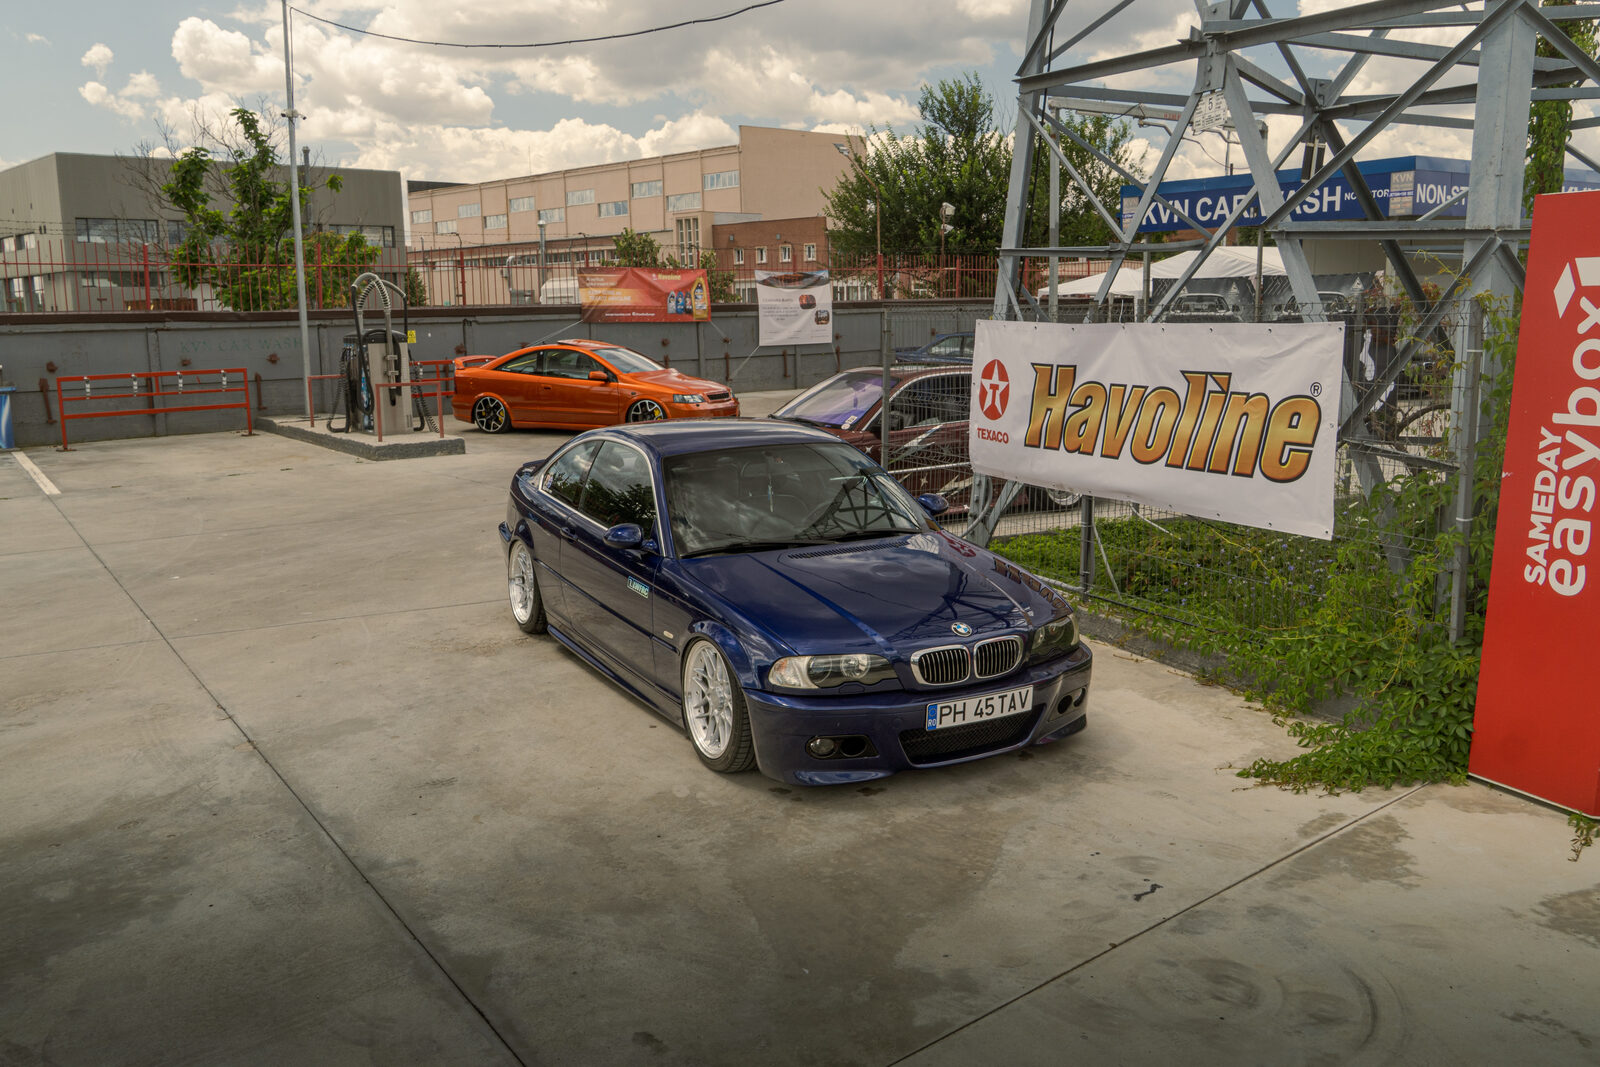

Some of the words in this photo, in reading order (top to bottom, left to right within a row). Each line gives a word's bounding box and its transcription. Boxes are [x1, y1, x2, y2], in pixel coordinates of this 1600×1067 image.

[1208, 97, 1213, 110] 5
[1142, 199, 1189, 225] KVN
[1260, 185, 1342, 217] ASH
[977, 427, 1009, 444] TEXACO
[1024, 362, 1322, 483] Havoline
[1548, 296, 1600, 597] easybox
[1524, 426, 1562, 586] SAMEDAY
[927, 719, 937, 727] RO
[938, 702, 966, 725] PH
[974, 697, 995, 718] 45
[998, 690, 1030, 714] TAV
